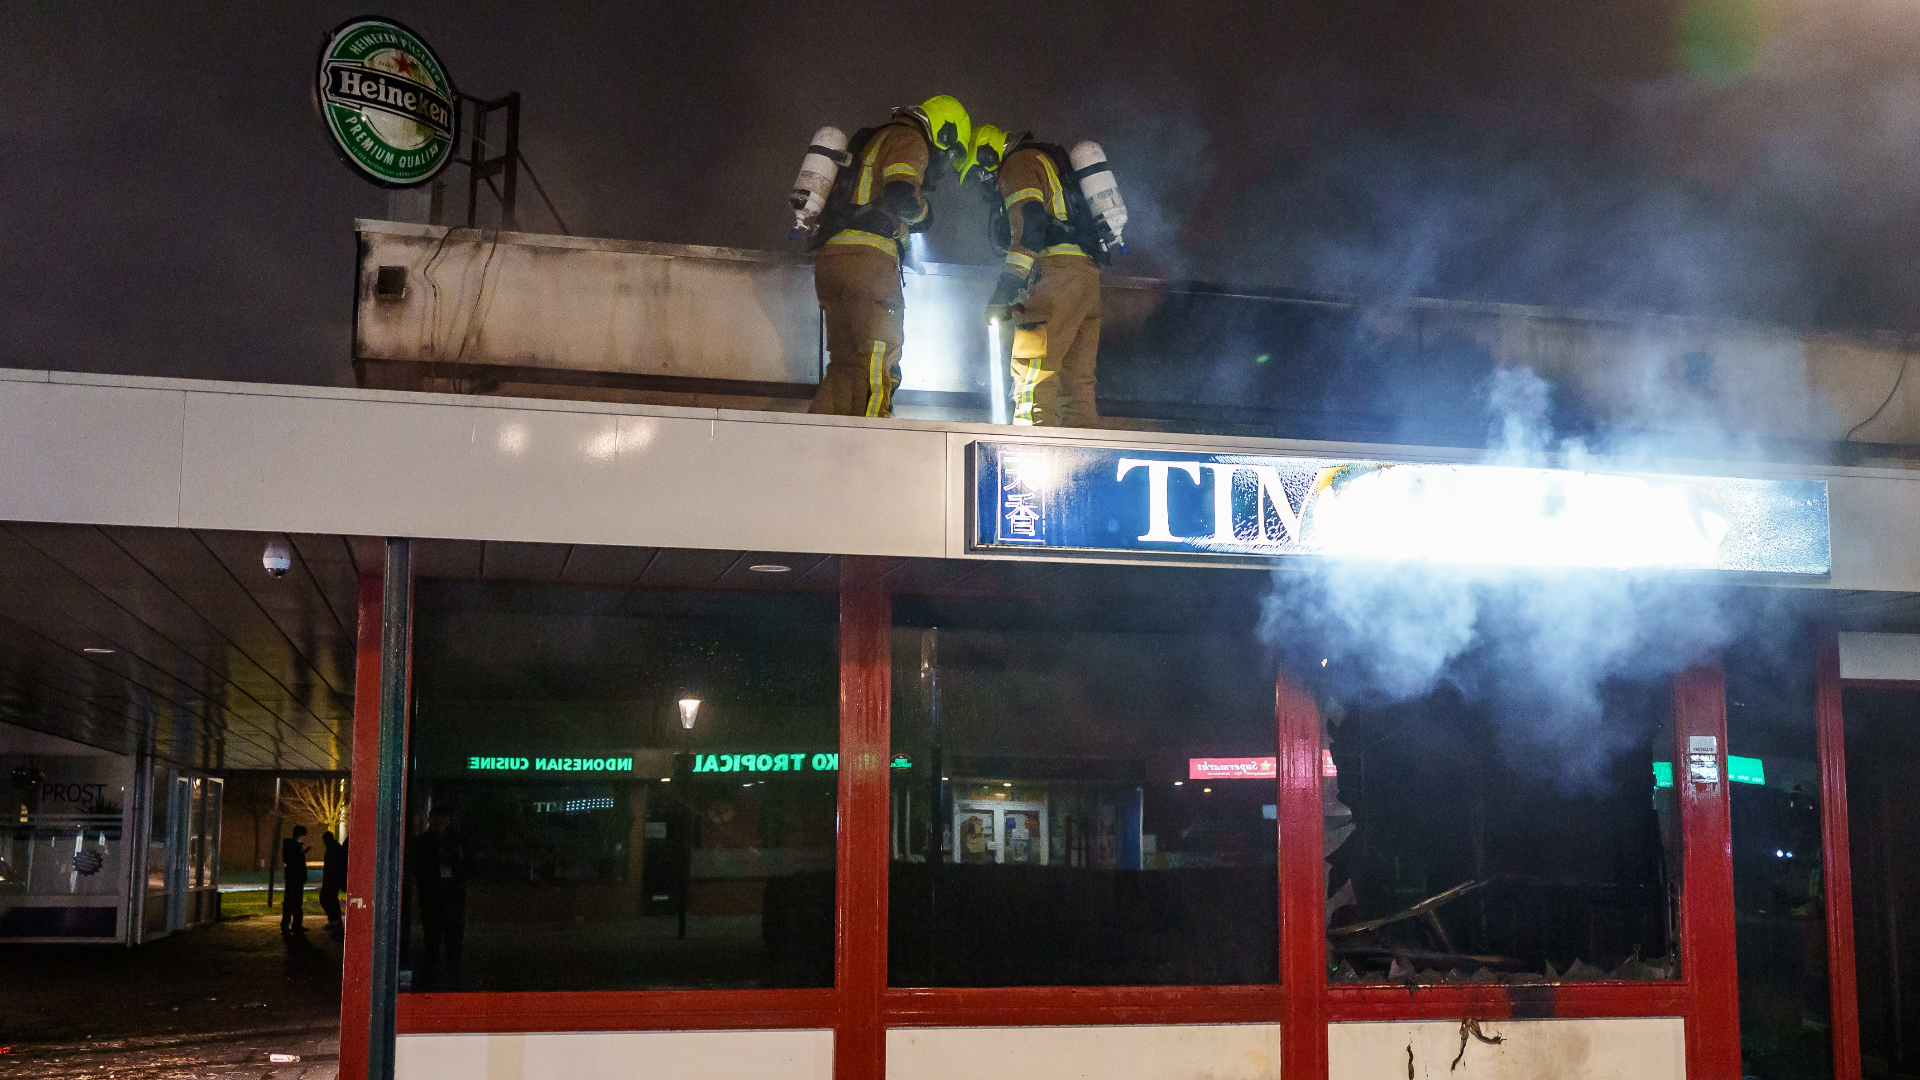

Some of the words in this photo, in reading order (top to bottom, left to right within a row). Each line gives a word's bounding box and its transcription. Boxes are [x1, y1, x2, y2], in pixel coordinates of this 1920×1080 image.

[350, 34, 399, 56] HEINEKEN
[339, 70, 449, 127] Heineken
[345, 116, 395, 166] PREMIUM
[399, 143, 439, 168] QUALITY
[42, 783, 107, 803] PROST
